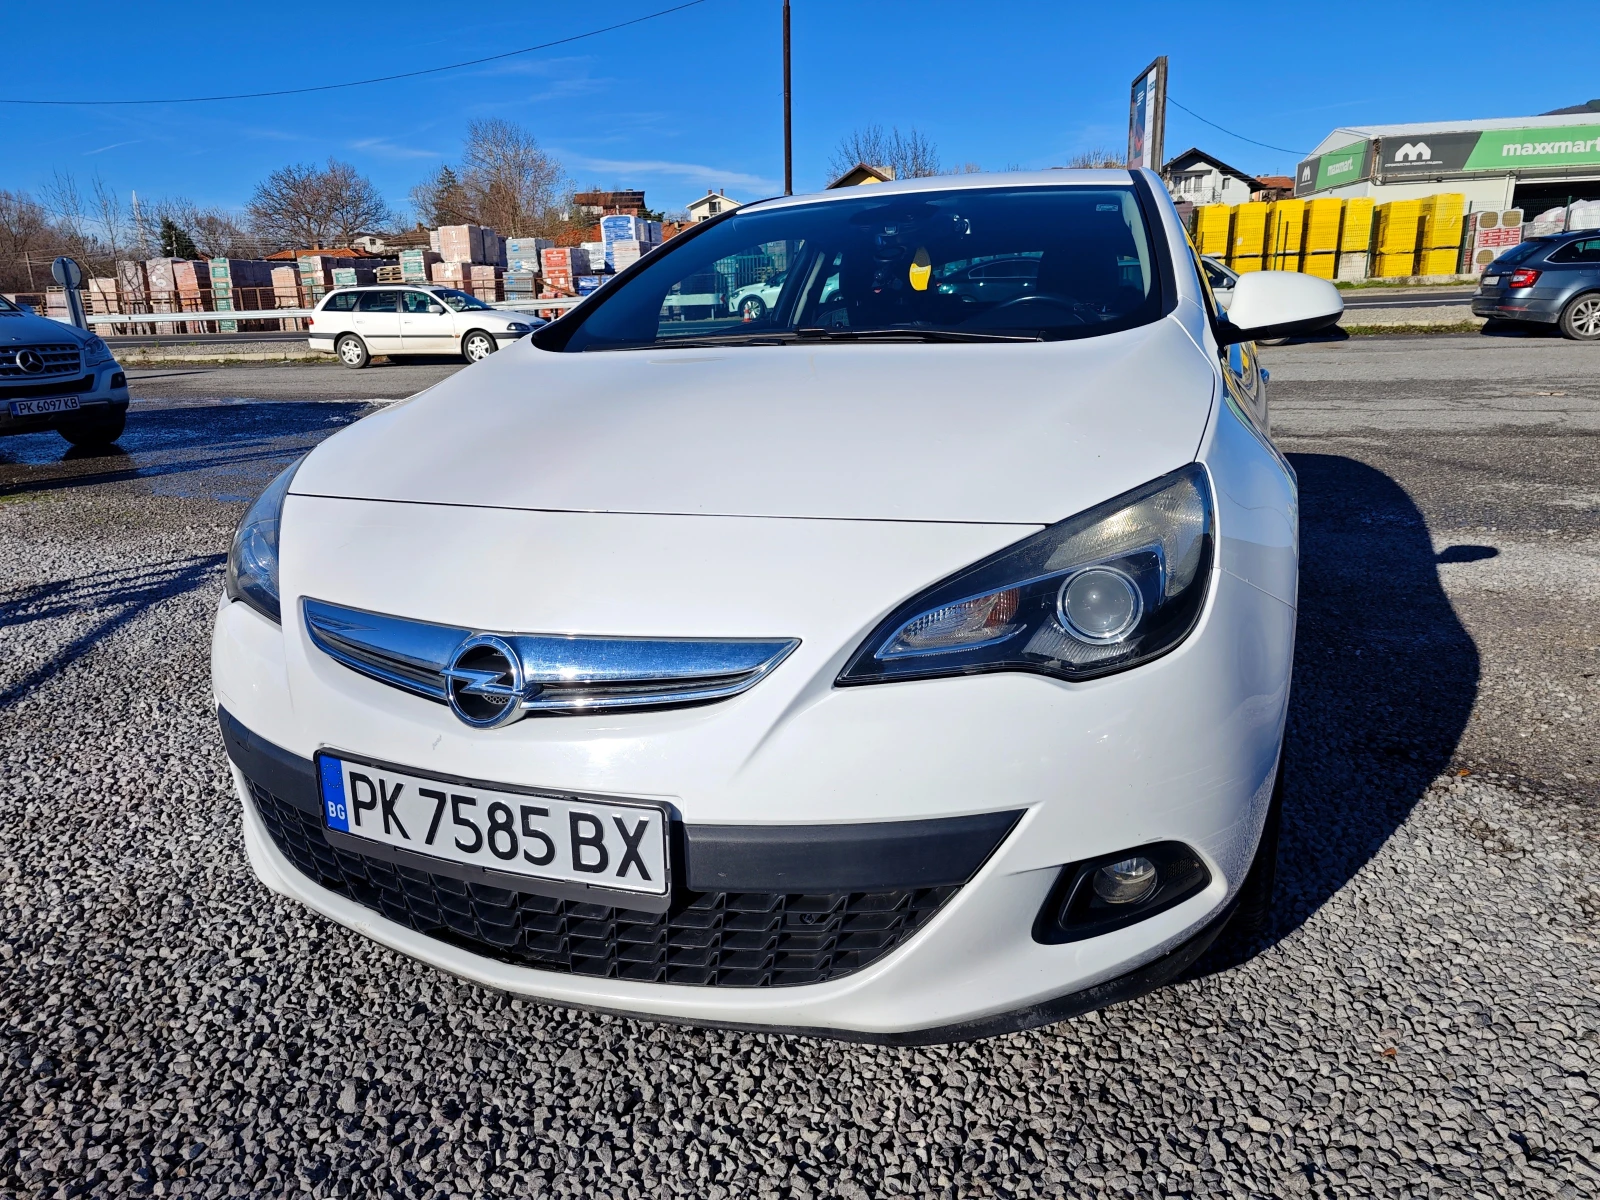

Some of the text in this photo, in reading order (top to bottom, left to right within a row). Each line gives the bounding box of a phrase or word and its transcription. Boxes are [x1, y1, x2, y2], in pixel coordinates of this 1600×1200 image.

[18, 398, 78, 414] PK 6097 KB
[327, 801, 346, 820] BG
[349, 771, 652, 881] PK 7585 BX
